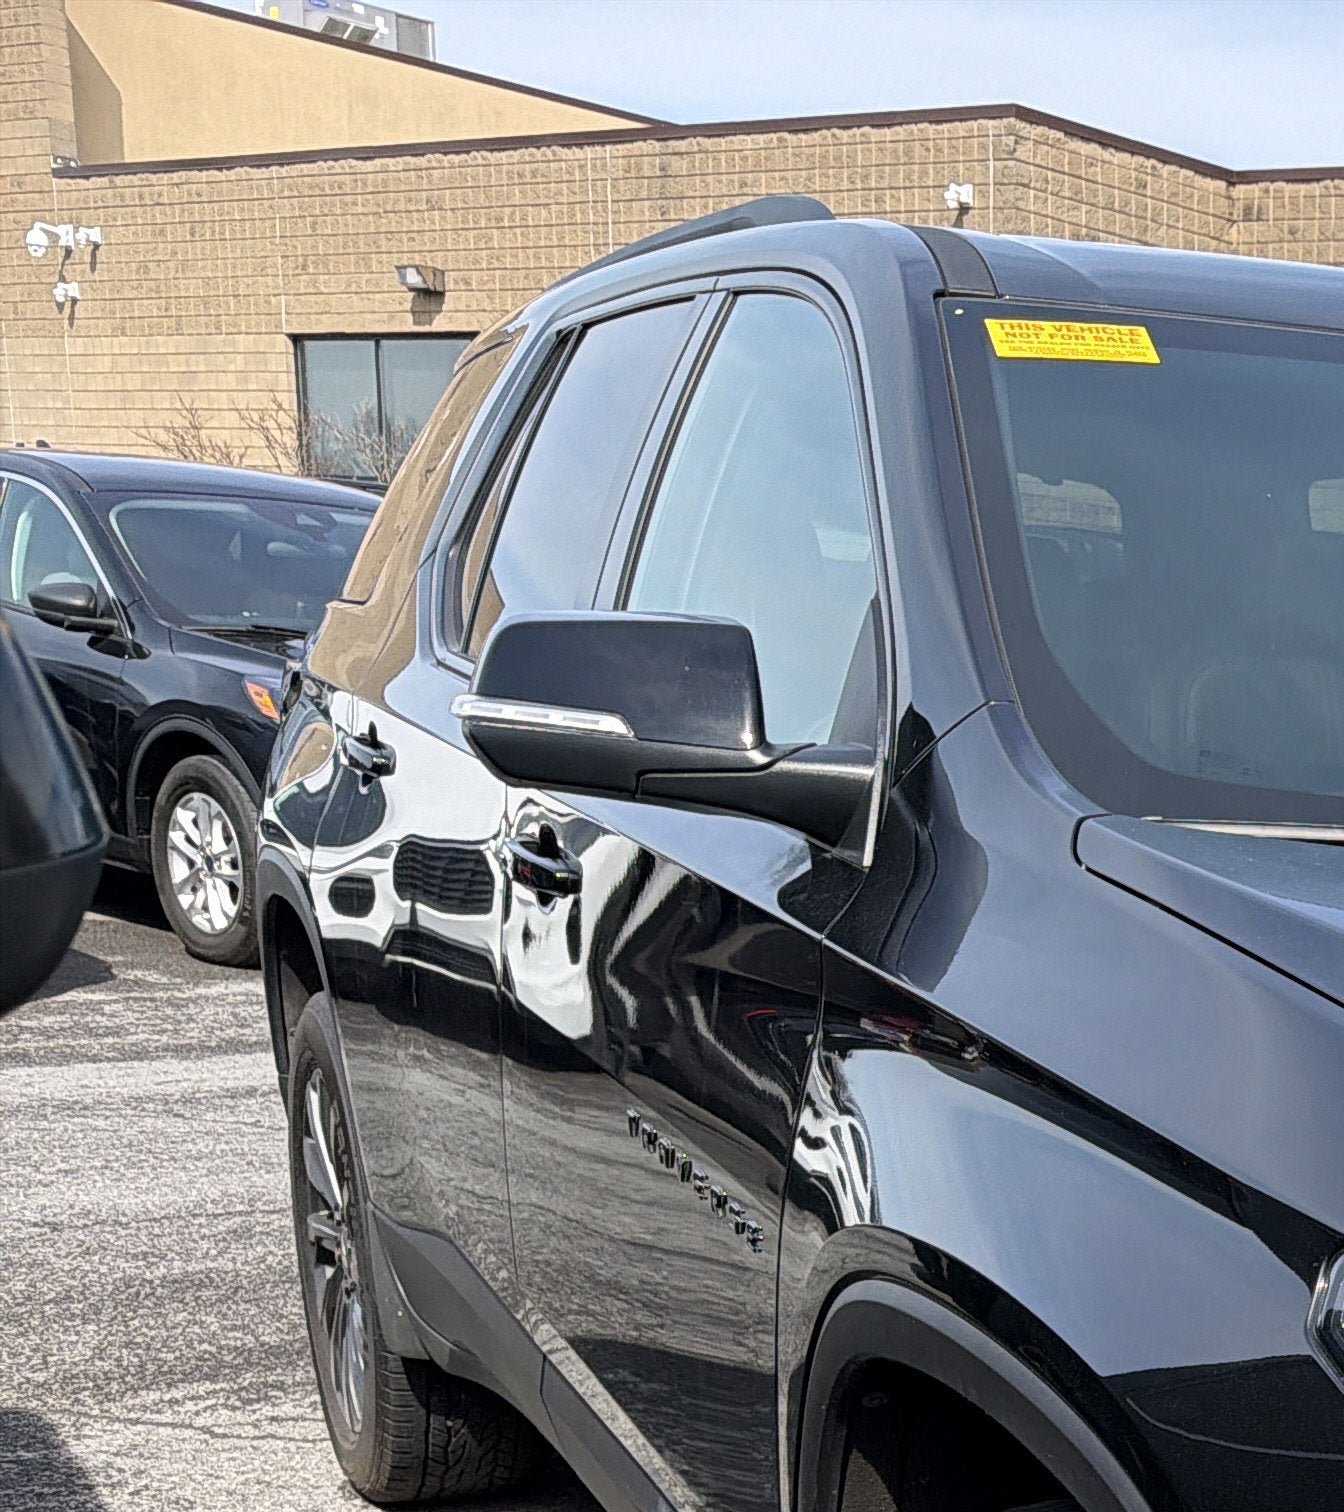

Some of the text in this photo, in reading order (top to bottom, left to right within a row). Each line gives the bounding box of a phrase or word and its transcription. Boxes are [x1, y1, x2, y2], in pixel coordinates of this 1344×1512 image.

[998, 322, 1143, 337] THIS VEHICLE
[1005, 331, 1141, 345] NOT FOR SALE
